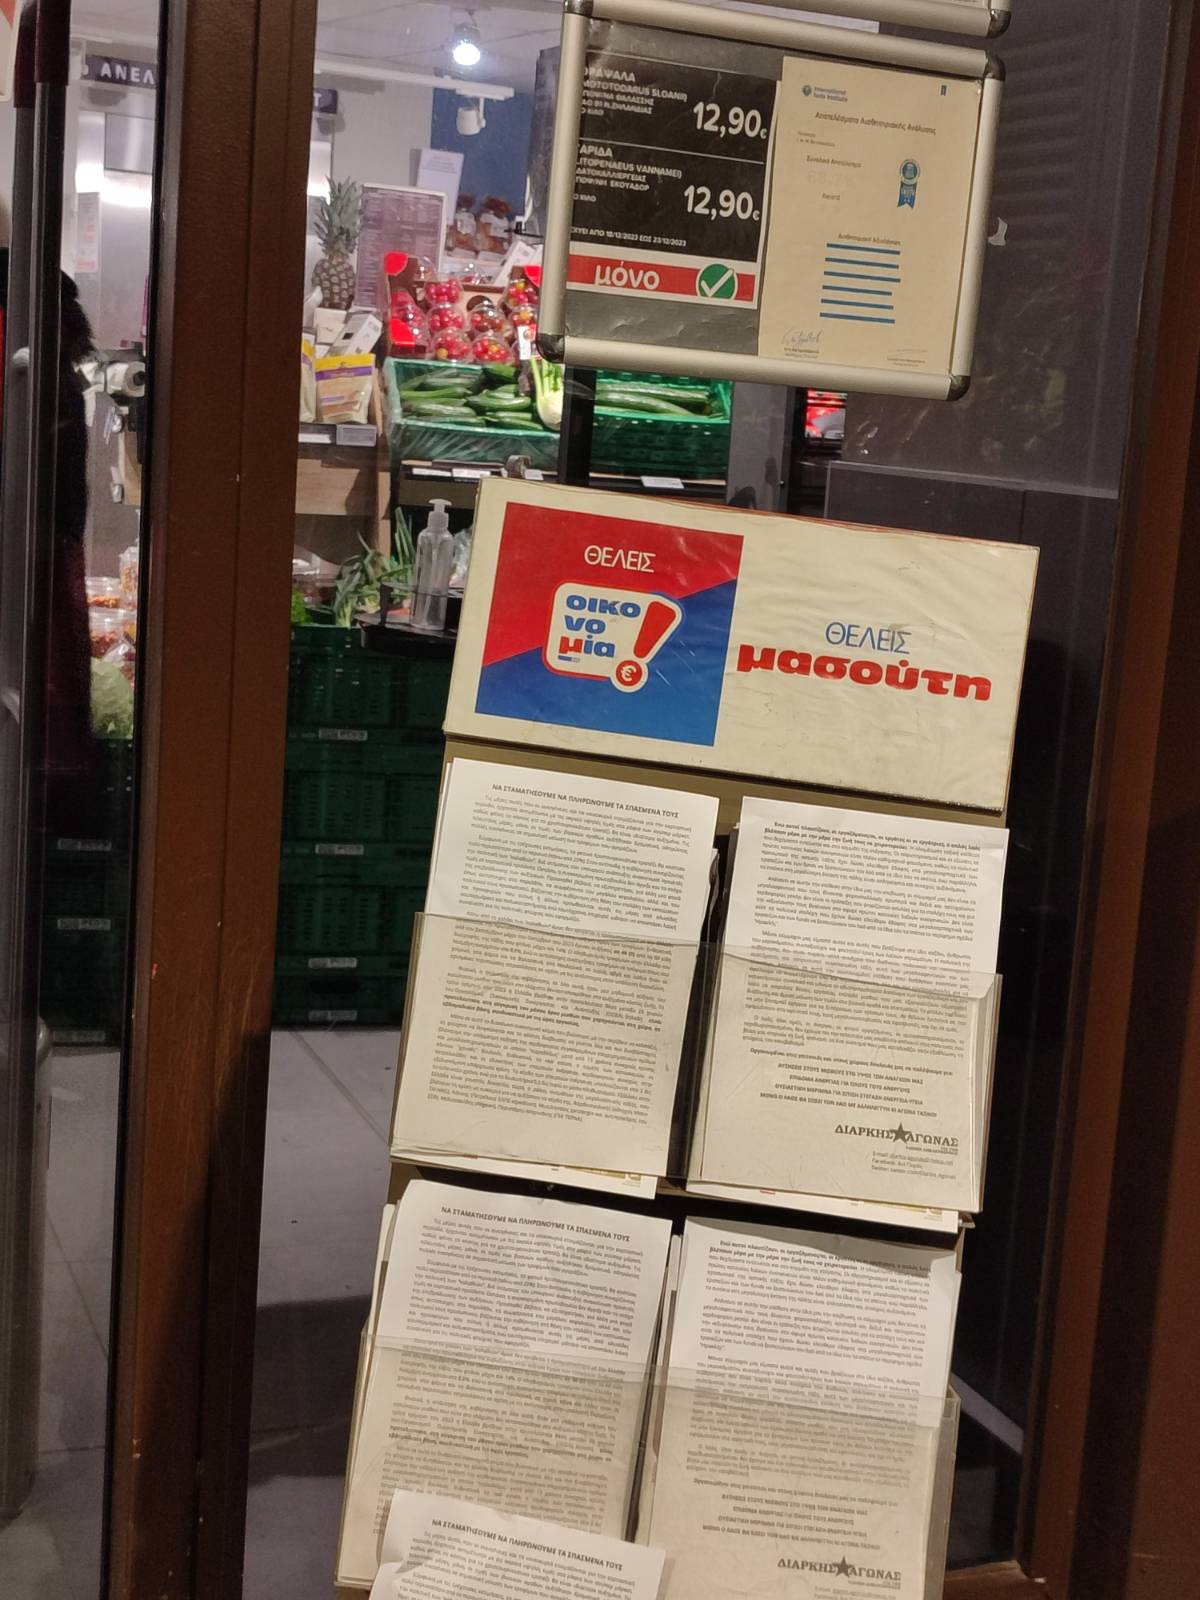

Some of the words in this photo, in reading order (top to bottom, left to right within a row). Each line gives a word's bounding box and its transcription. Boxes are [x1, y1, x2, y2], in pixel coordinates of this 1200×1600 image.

[578, 144, 613, 157] ΑΡΙΔΑ
[595, 260, 660, 290] μόνο
[584, 544, 656, 573] ΘΕΛΕΙΣ
[566, 594, 641, 618] οικο
[564, 614, 606, 634] νο
[825, 621, 912, 655] ΘΕΛΕΙΣ
[736, 644, 992, 701] μασούτη
[503, 785, 556, 799] ΣΤΑΜΑΤΗΣΟΥΜΕ
[568, 795, 614, 808] ΠΛΗΡΩΝΟΥΜΕ
[625, 803, 660, 815] ΣΠΑΣΜΕΝΑ
[662, 808, 679, 817] ΤΟΥΣ
[834, 1124, 893, 1140] ΔΙΑΡΚΗΣ
[907, 1133, 959, 1147] ΑΓΩΝΑΣ
[452, 1208, 507, 1222] ΣΤΑΜΑΤΗΣΟΥΜΕ
[518, 1218, 565, 1231] ΠΛΗΡΩΝΟΥΜΕ
[576, 1226, 612, 1238] ΣΠΑΣΜΕΝΑ
[613, 1232, 630, 1241] ΤΟΥΣ
[432, 1519, 442, 1529] ΝΑ
[497, 1534, 508, 1544] ΝΑ
[508, 1537, 557, 1556] ΠΛΗΡΩΝΟΥΜΕ
[558, 1548, 566, 1558] ΤΑ
[567, 1550, 604, 1567] ΣΠΑΣΜΕΝΑ
[605, 1559, 623, 1571] ΤΟΥΣ
[777, 1557, 836, 1573] ΔΙΑΡΚΗΣ
[850, 1566, 901, 1581] ΑΓΩΝΑΣ
